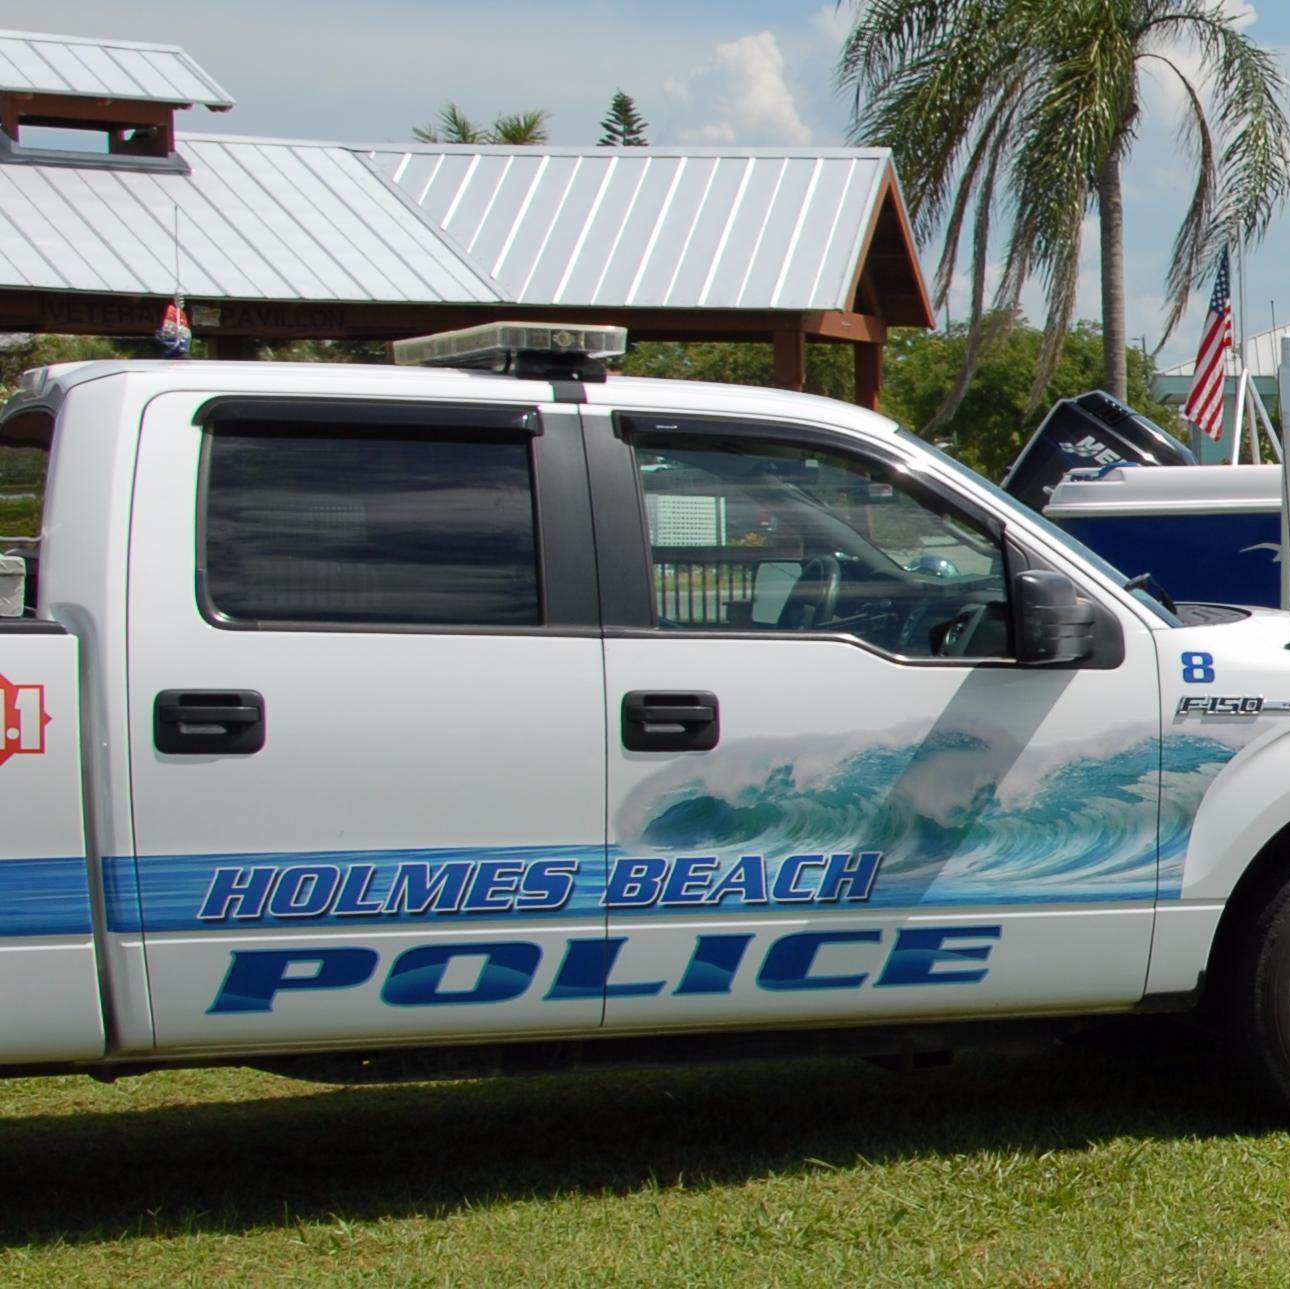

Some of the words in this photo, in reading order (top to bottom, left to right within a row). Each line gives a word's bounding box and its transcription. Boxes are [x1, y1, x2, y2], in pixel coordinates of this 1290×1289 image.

[1075, 435, 1127, 466] ME
[1181, 651, 1215, 683] 8
[197, 858, 579, 920] HOLMES
[600, 851, 883, 908] BEACH
[204, 924, 1003, 1015] POLICE
